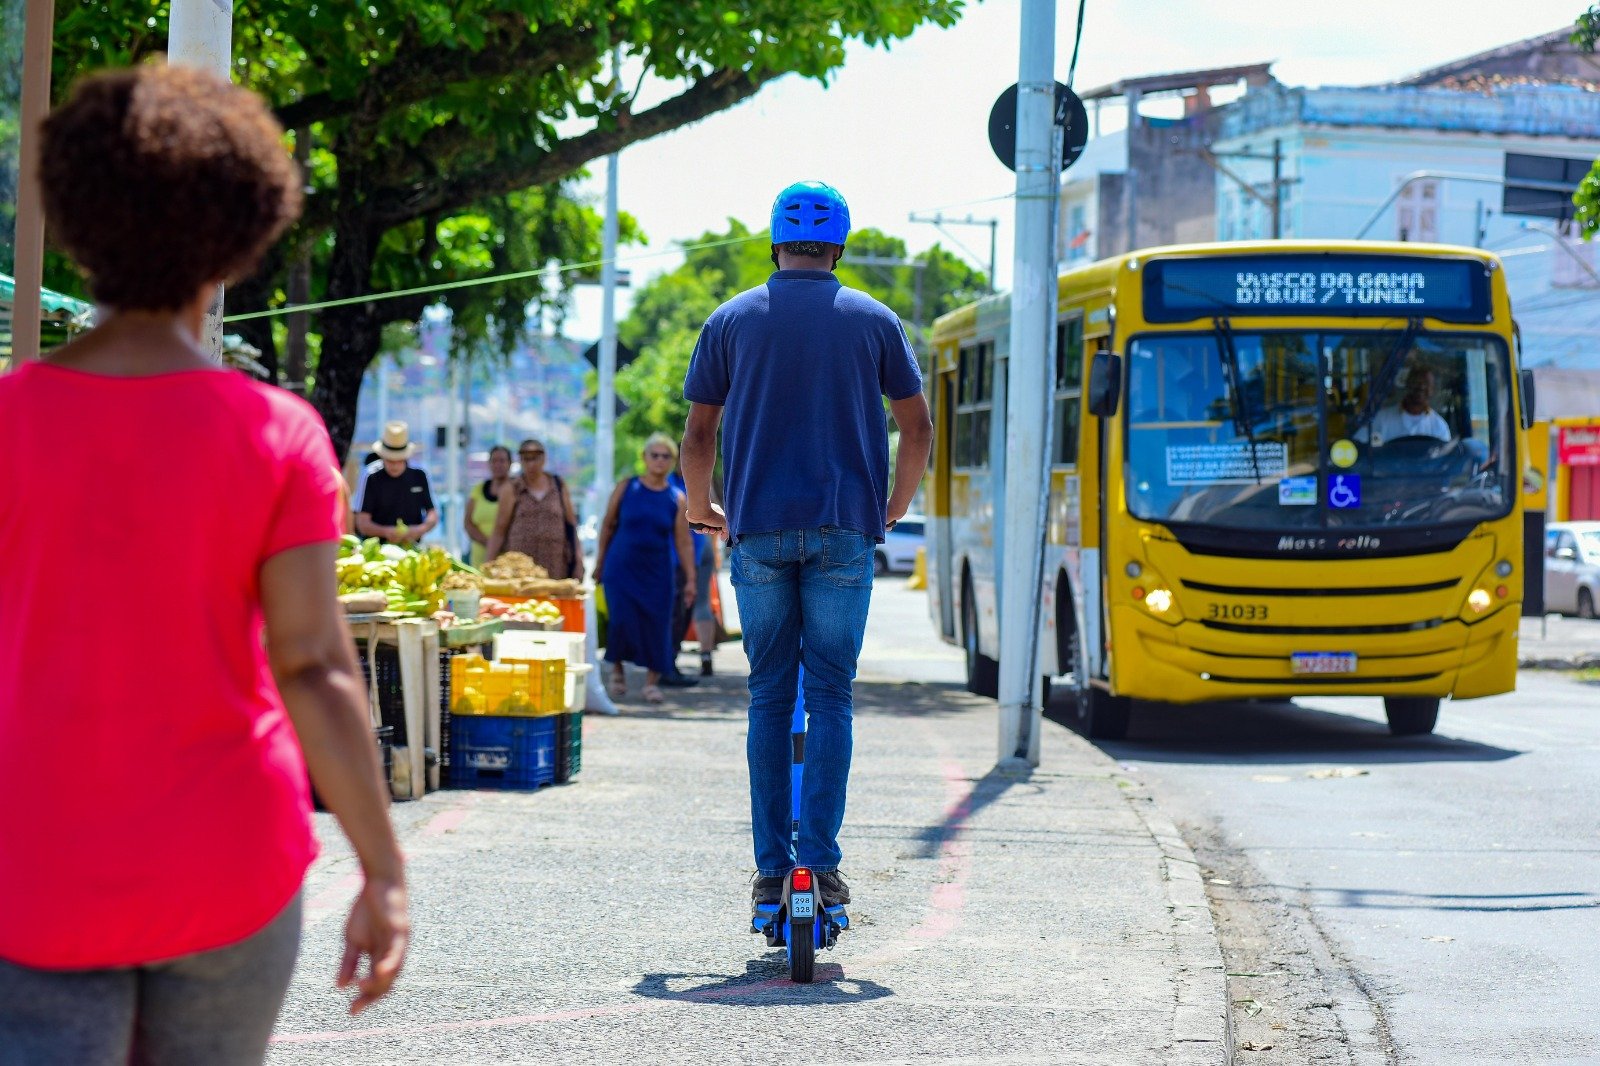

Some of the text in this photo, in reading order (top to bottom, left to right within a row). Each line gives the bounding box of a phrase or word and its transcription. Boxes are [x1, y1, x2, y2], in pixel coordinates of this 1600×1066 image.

[1237, 272, 1425, 288] VASCO DA GAMA
[1208, 603, 1269, 620] 31033
